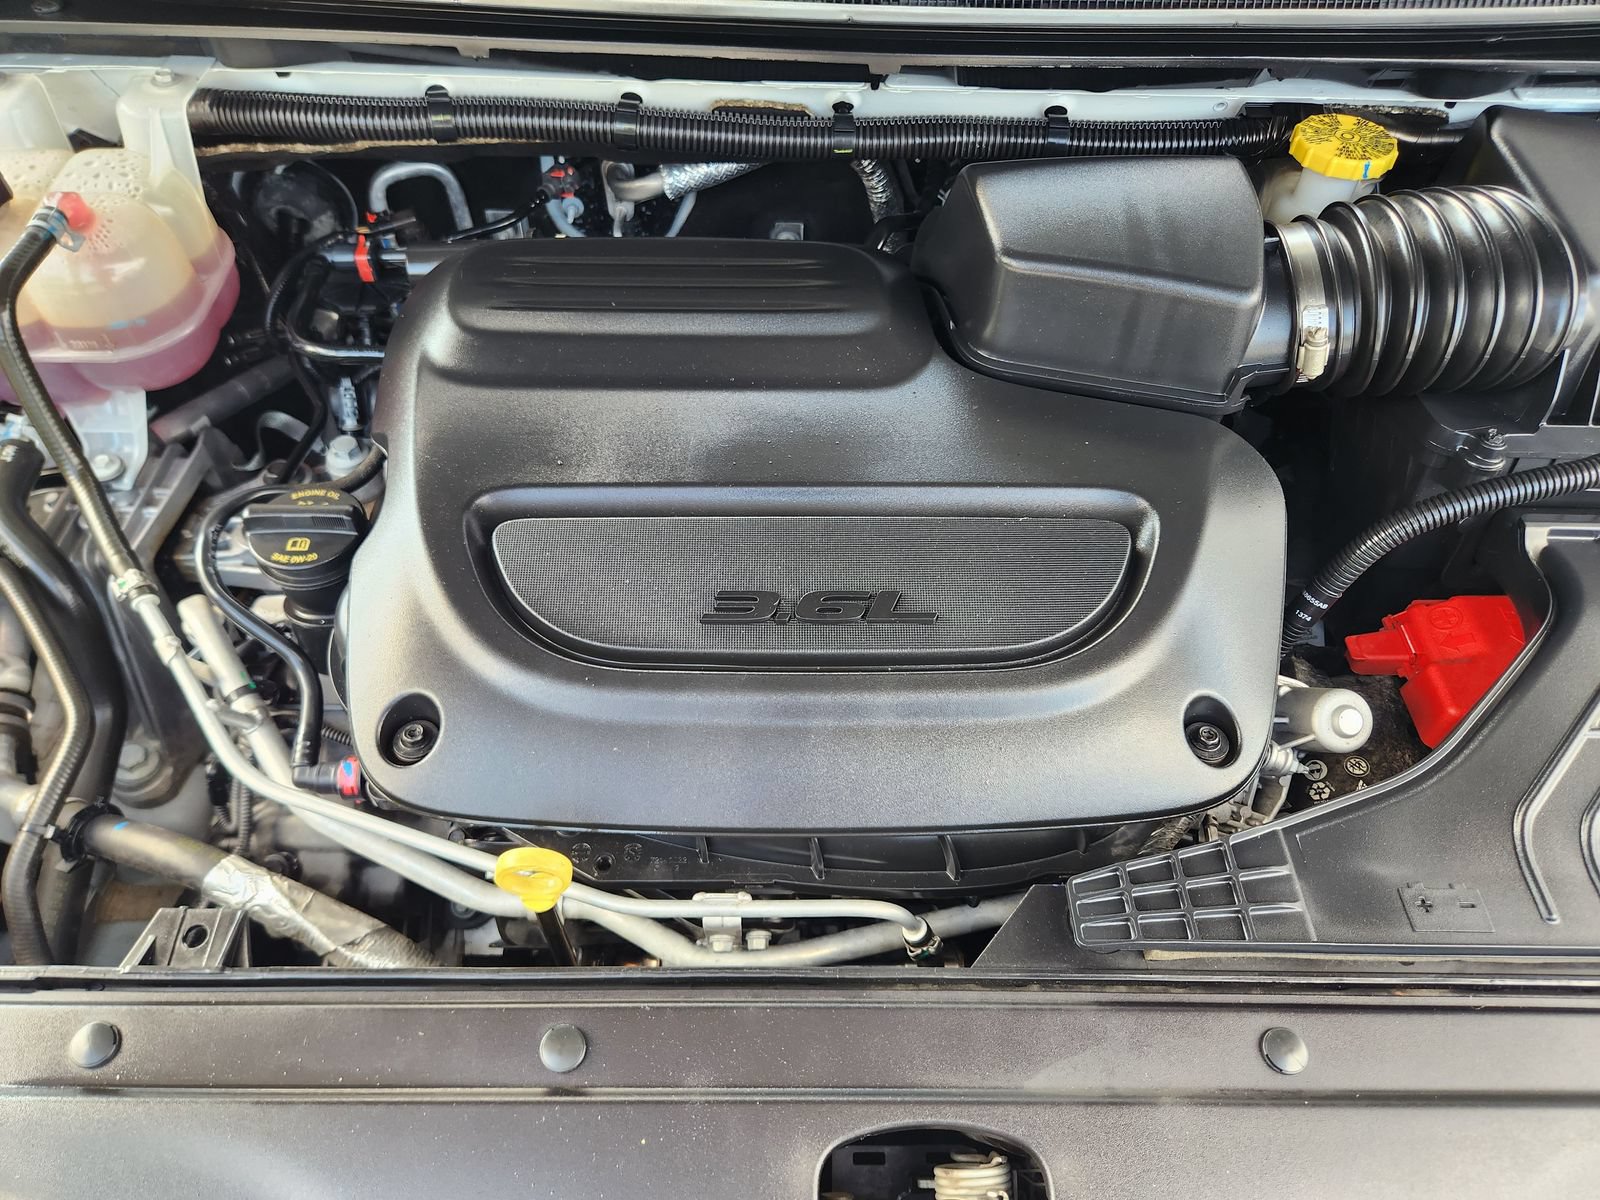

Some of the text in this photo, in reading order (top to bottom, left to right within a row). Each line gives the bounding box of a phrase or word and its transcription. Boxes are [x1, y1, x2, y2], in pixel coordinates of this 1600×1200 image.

[291, 489, 340, 500] ENGINE OIL
[271, 552, 318, 564] SAE 0W-20
[700, 589, 938, 625] 3.6L
[1295, 610, 1311, 621] 1374
